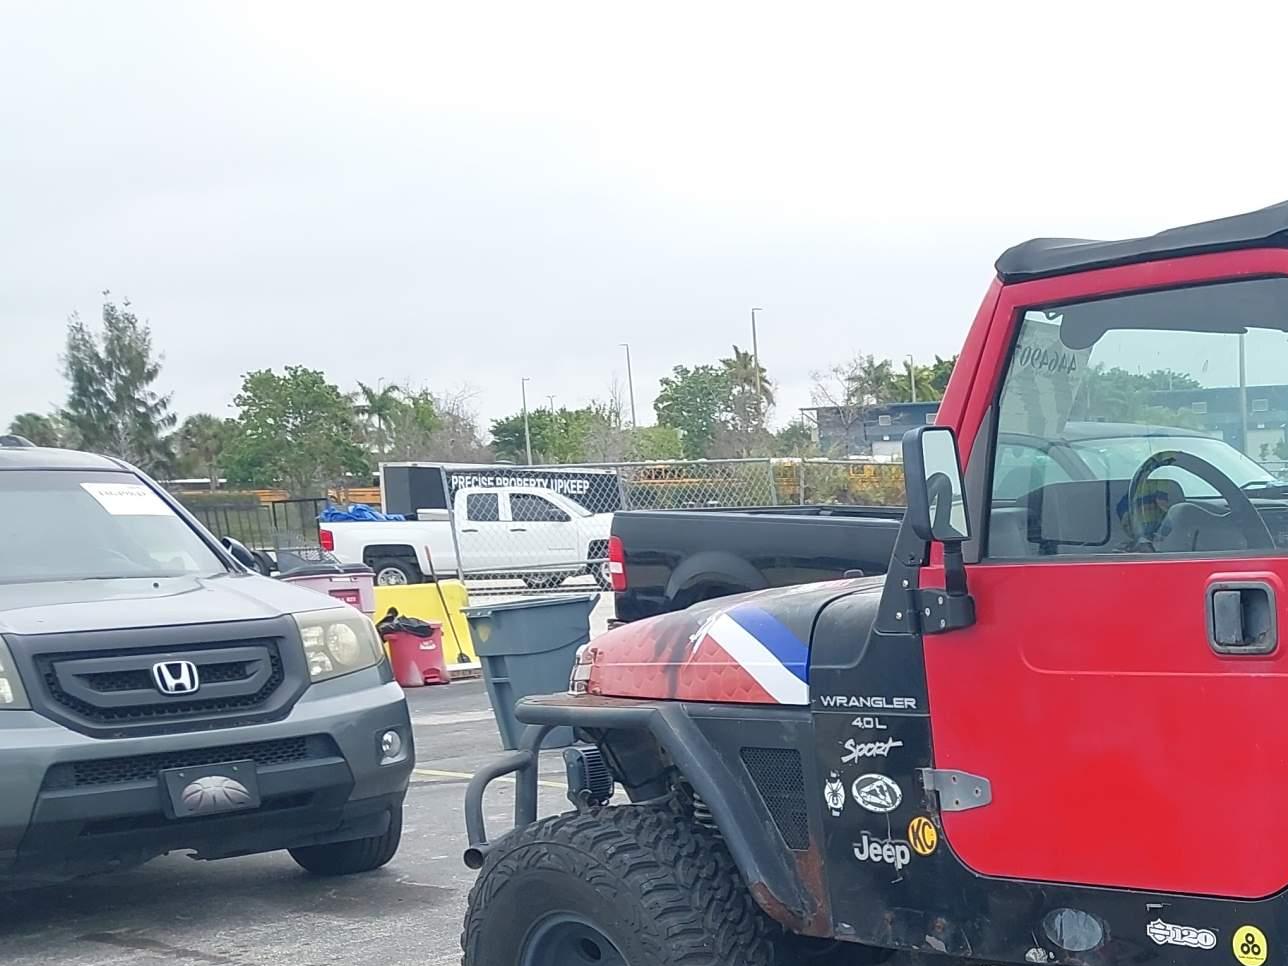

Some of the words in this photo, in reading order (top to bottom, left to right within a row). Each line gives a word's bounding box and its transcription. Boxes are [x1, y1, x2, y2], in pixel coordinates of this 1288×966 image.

[451, 475, 495, 489] PRECISE
[496, 476, 549, 488] PROPERTY
[551, 479, 590, 494] UPKEEP
[820, 695, 917, 709] WRANGLER
[840, 737, 903, 764] Sport
[909, 818, 936, 853] KC
[853, 834, 911, 870] Jeep
